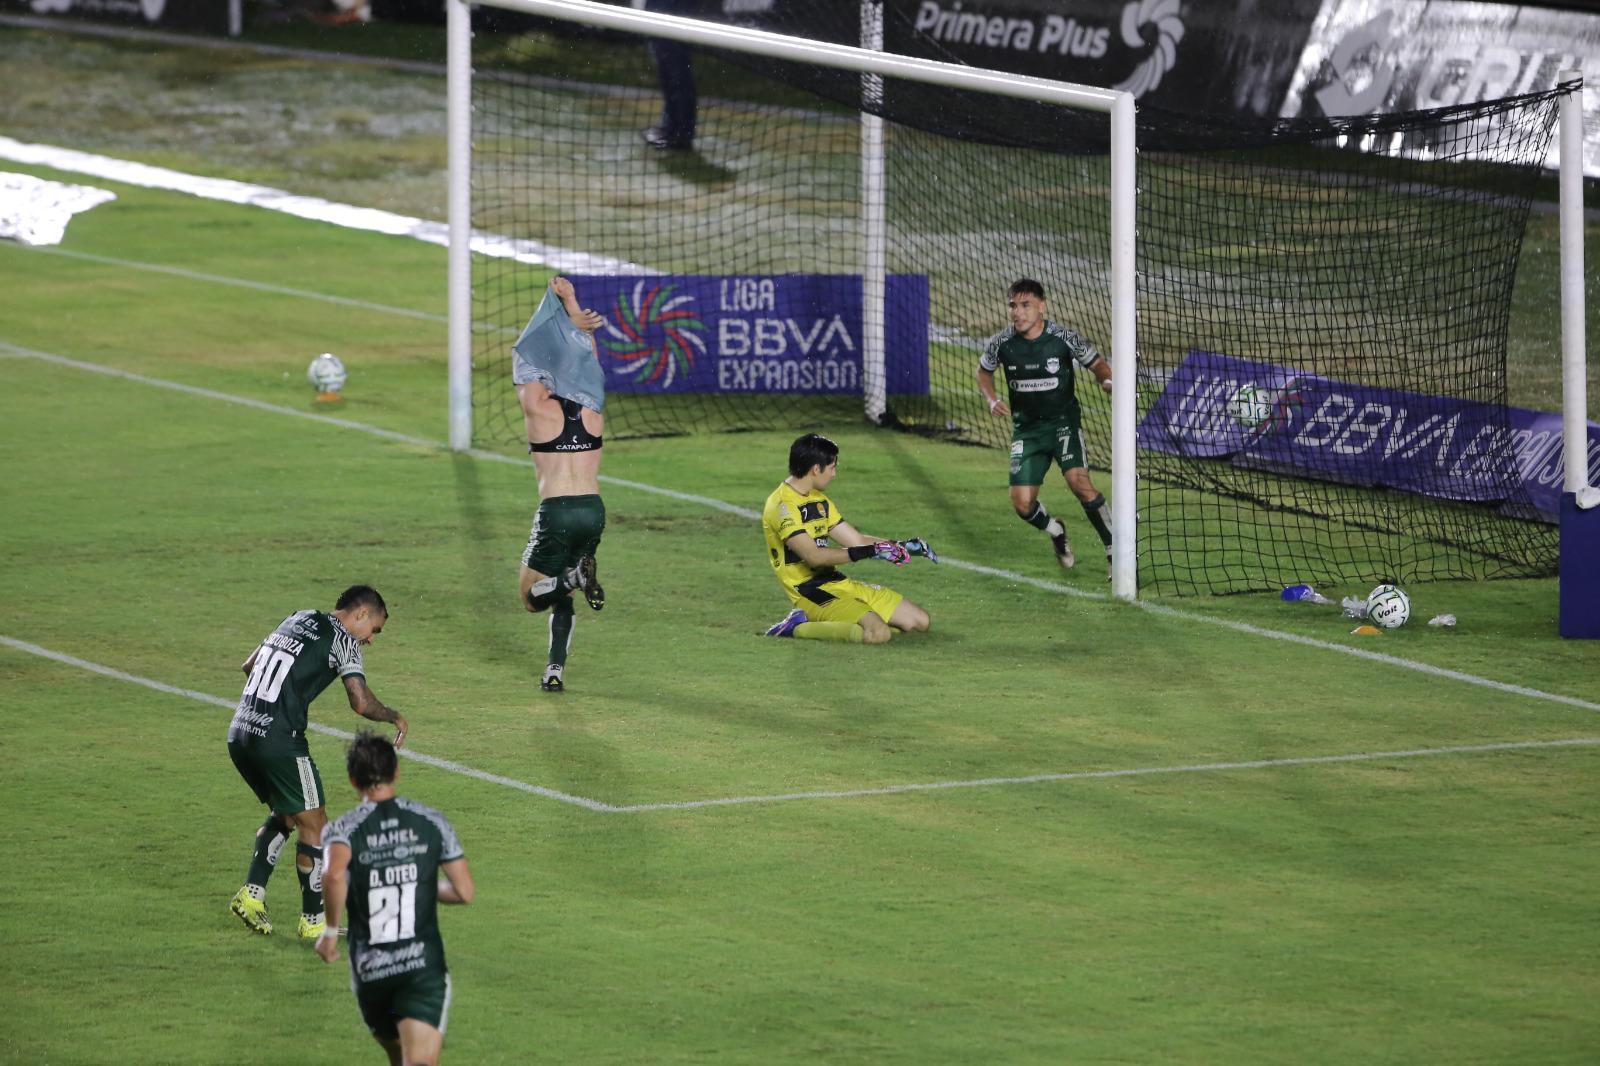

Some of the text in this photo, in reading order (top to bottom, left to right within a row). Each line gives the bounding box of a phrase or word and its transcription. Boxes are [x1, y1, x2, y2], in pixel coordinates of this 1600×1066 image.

[915, 2, 1110, 58] Primera Plus
[720, 278, 775, 312] LIGA
[718, 314, 856, 356] BBVA
[1294, 393, 1460, 468] BBVA
[555, 442, 593, 451] CATAPULT
[1058, 435, 1071, 456] 7
[1378, 605, 1398, 619] Voit
[366, 828, 419, 848] NAHEL
[369, 863, 418, 888] D. OTEO
[368, 881, 418, 945] 21
